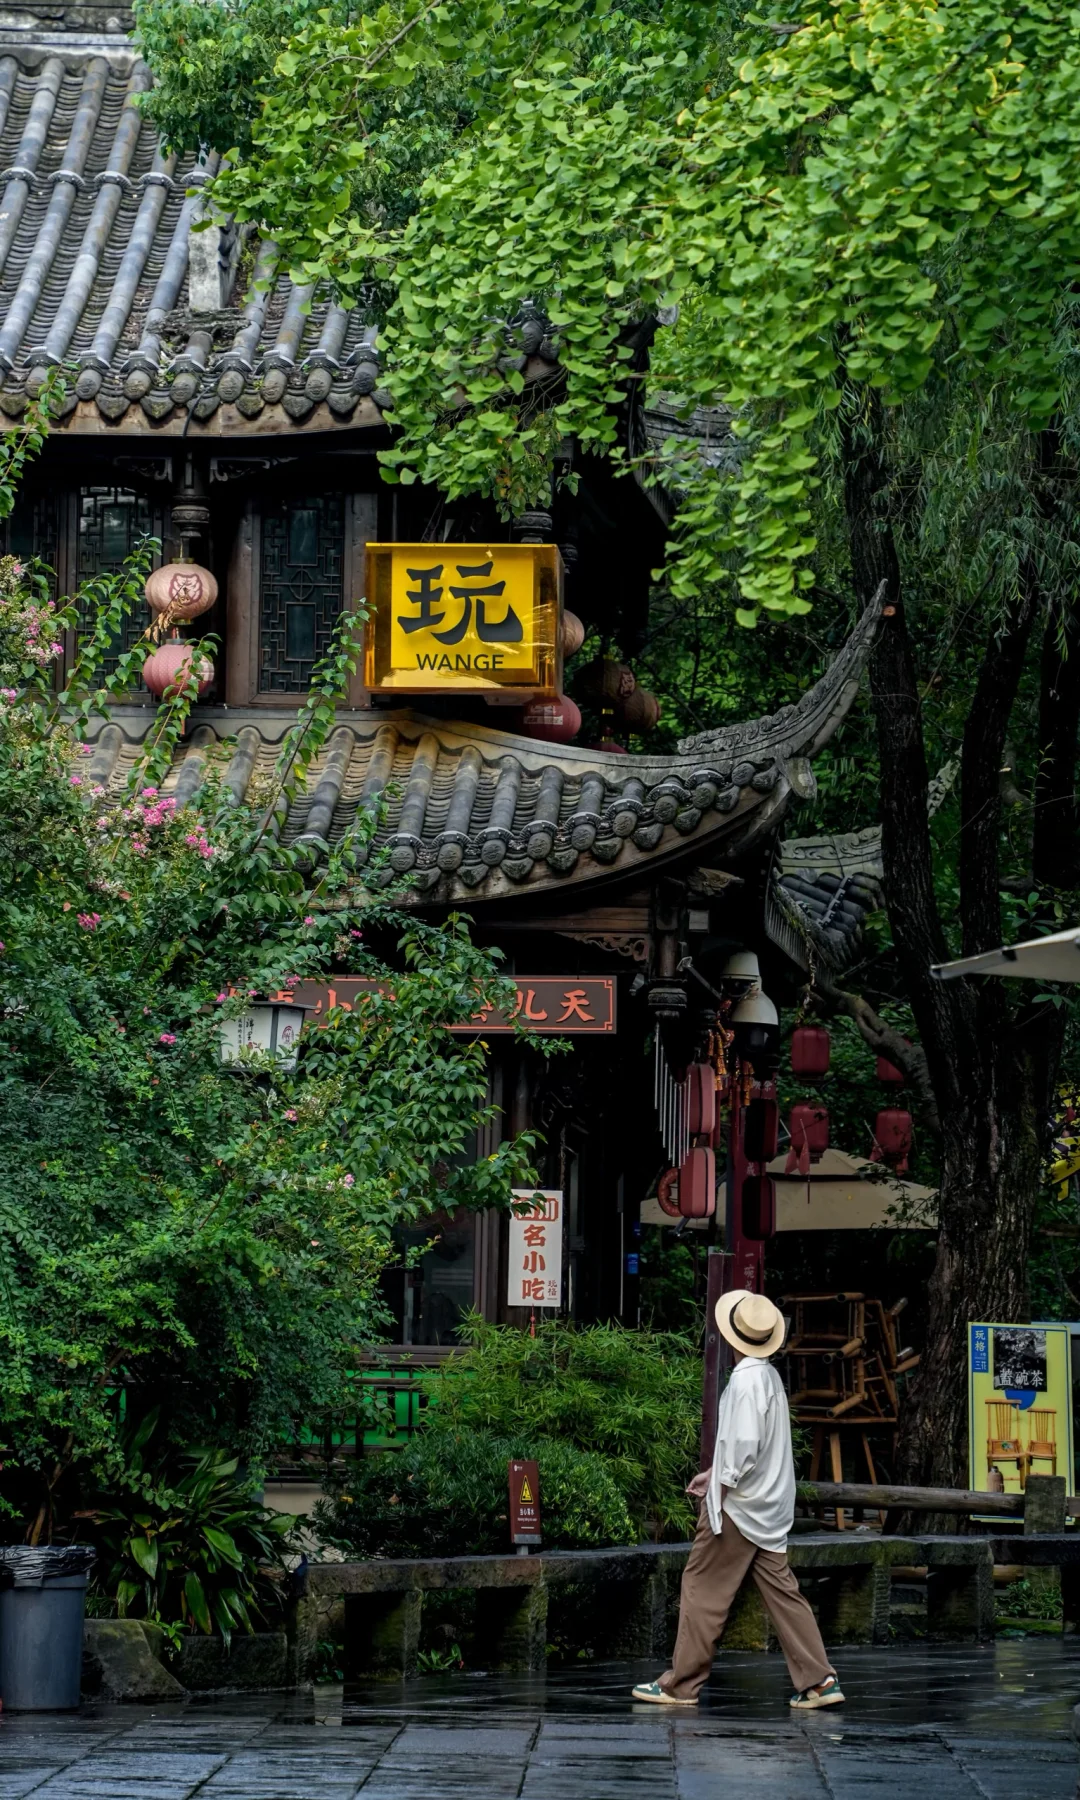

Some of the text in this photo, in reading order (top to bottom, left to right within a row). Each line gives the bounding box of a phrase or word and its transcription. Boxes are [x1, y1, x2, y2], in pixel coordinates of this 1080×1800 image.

[397, 561, 524, 645] 玩
[416, 654, 505, 671] WANGE
[522, 1224, 546, 1301] 名小吃
[975, 1330, 986, 1352] 玩格
